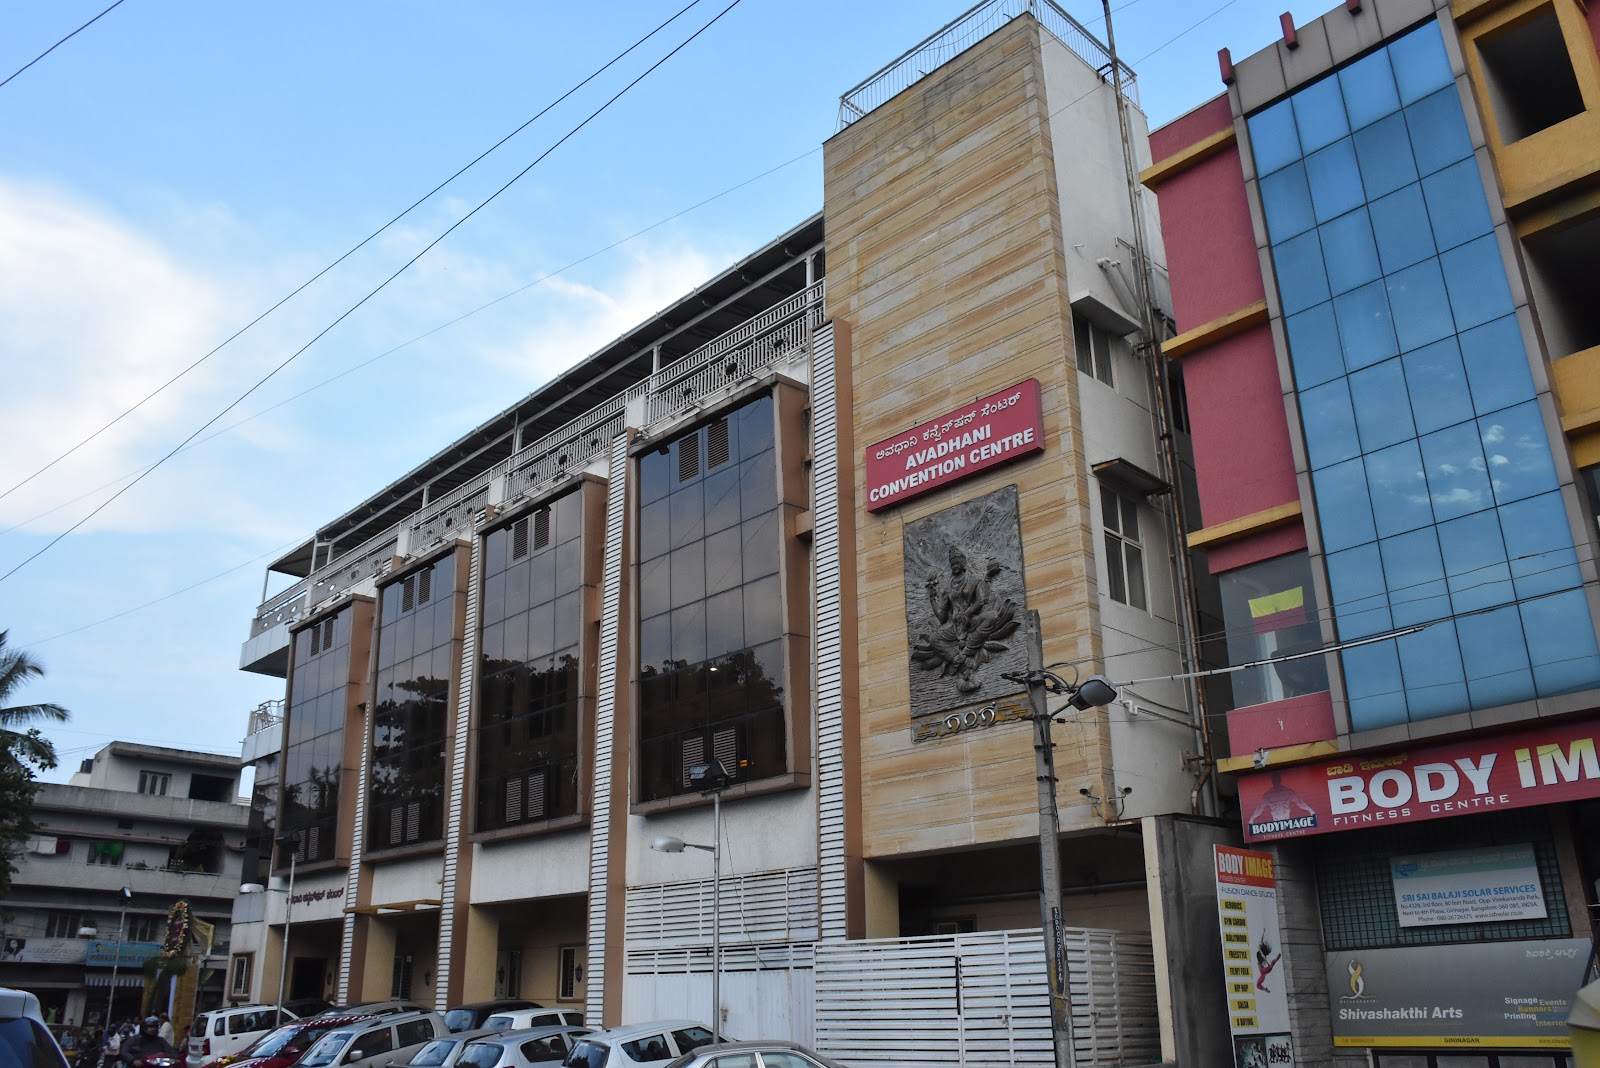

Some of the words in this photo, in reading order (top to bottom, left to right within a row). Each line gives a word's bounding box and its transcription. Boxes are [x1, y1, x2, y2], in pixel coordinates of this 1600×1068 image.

[905, 424, 991, 471] AVADHANI
[869, 454, 966, 503] CONVENTION
[969, 428, 1035, 464] CENTRE
[1327, 753, 1498, 815] BODY
[1333, 808, 1411, 826] FITNESS
[1429, 794, 1510, 813] CENTRE
[1251, 816, 1315, 835] BODYIMAGE
[1217, 852, 1244, 875] BODY
[1244, 857, 1274, 879] IMAGE
[1221, 886, 1240, 895] FUSION
[1241, 888, 1258, 897] DANCE
[1258, 890, 1275, 899] STUDIO
[1401, 894, 1415, 902] SRI
[1416, 893, 1430, 901] SAI
[1431, 890, 1461, 900] BALAJI
[1462, 888, 1492, 897] SOLAR
[1493, 884, 1536, 895] SERVICES
[1226, 933, 1247, 943] BOLLYWOOD
[1229, 950, 1248, 959] FREESTYLE
[1237, 1000, 1249, 1010] SALSA
[1504, 997, 1538, 1005] Signage
[1339, 1007, 1428, 1020] Shivashakthi
[1431, 1006, 1464, 1020] Arts
[1517, 1005, 1553, 1013] Banners
[1503, 1012, 1537, 1021] Printing
